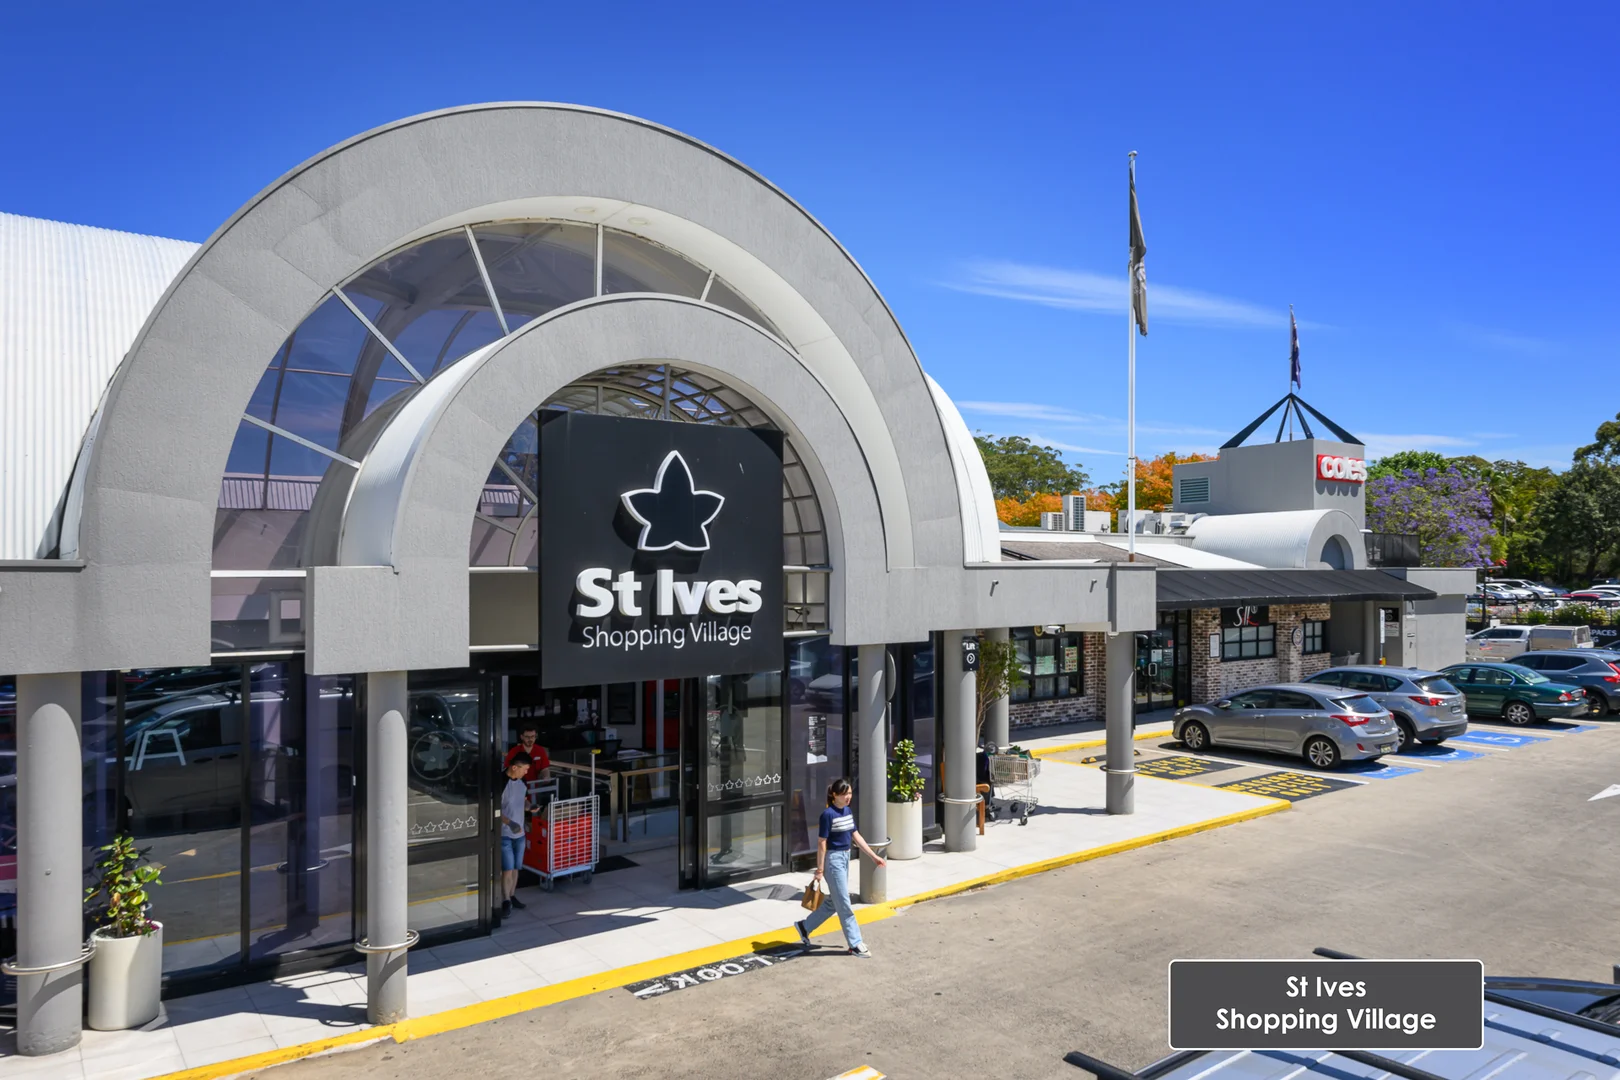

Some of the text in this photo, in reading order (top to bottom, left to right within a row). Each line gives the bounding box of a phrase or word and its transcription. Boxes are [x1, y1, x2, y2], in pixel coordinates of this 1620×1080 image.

[1321, 456, 1368, 482] coles
[576, 567, 762, 618] St Ives
[582, 621, 752, 651] Shopping Village
[668, 956, 773, 989] LOOK
